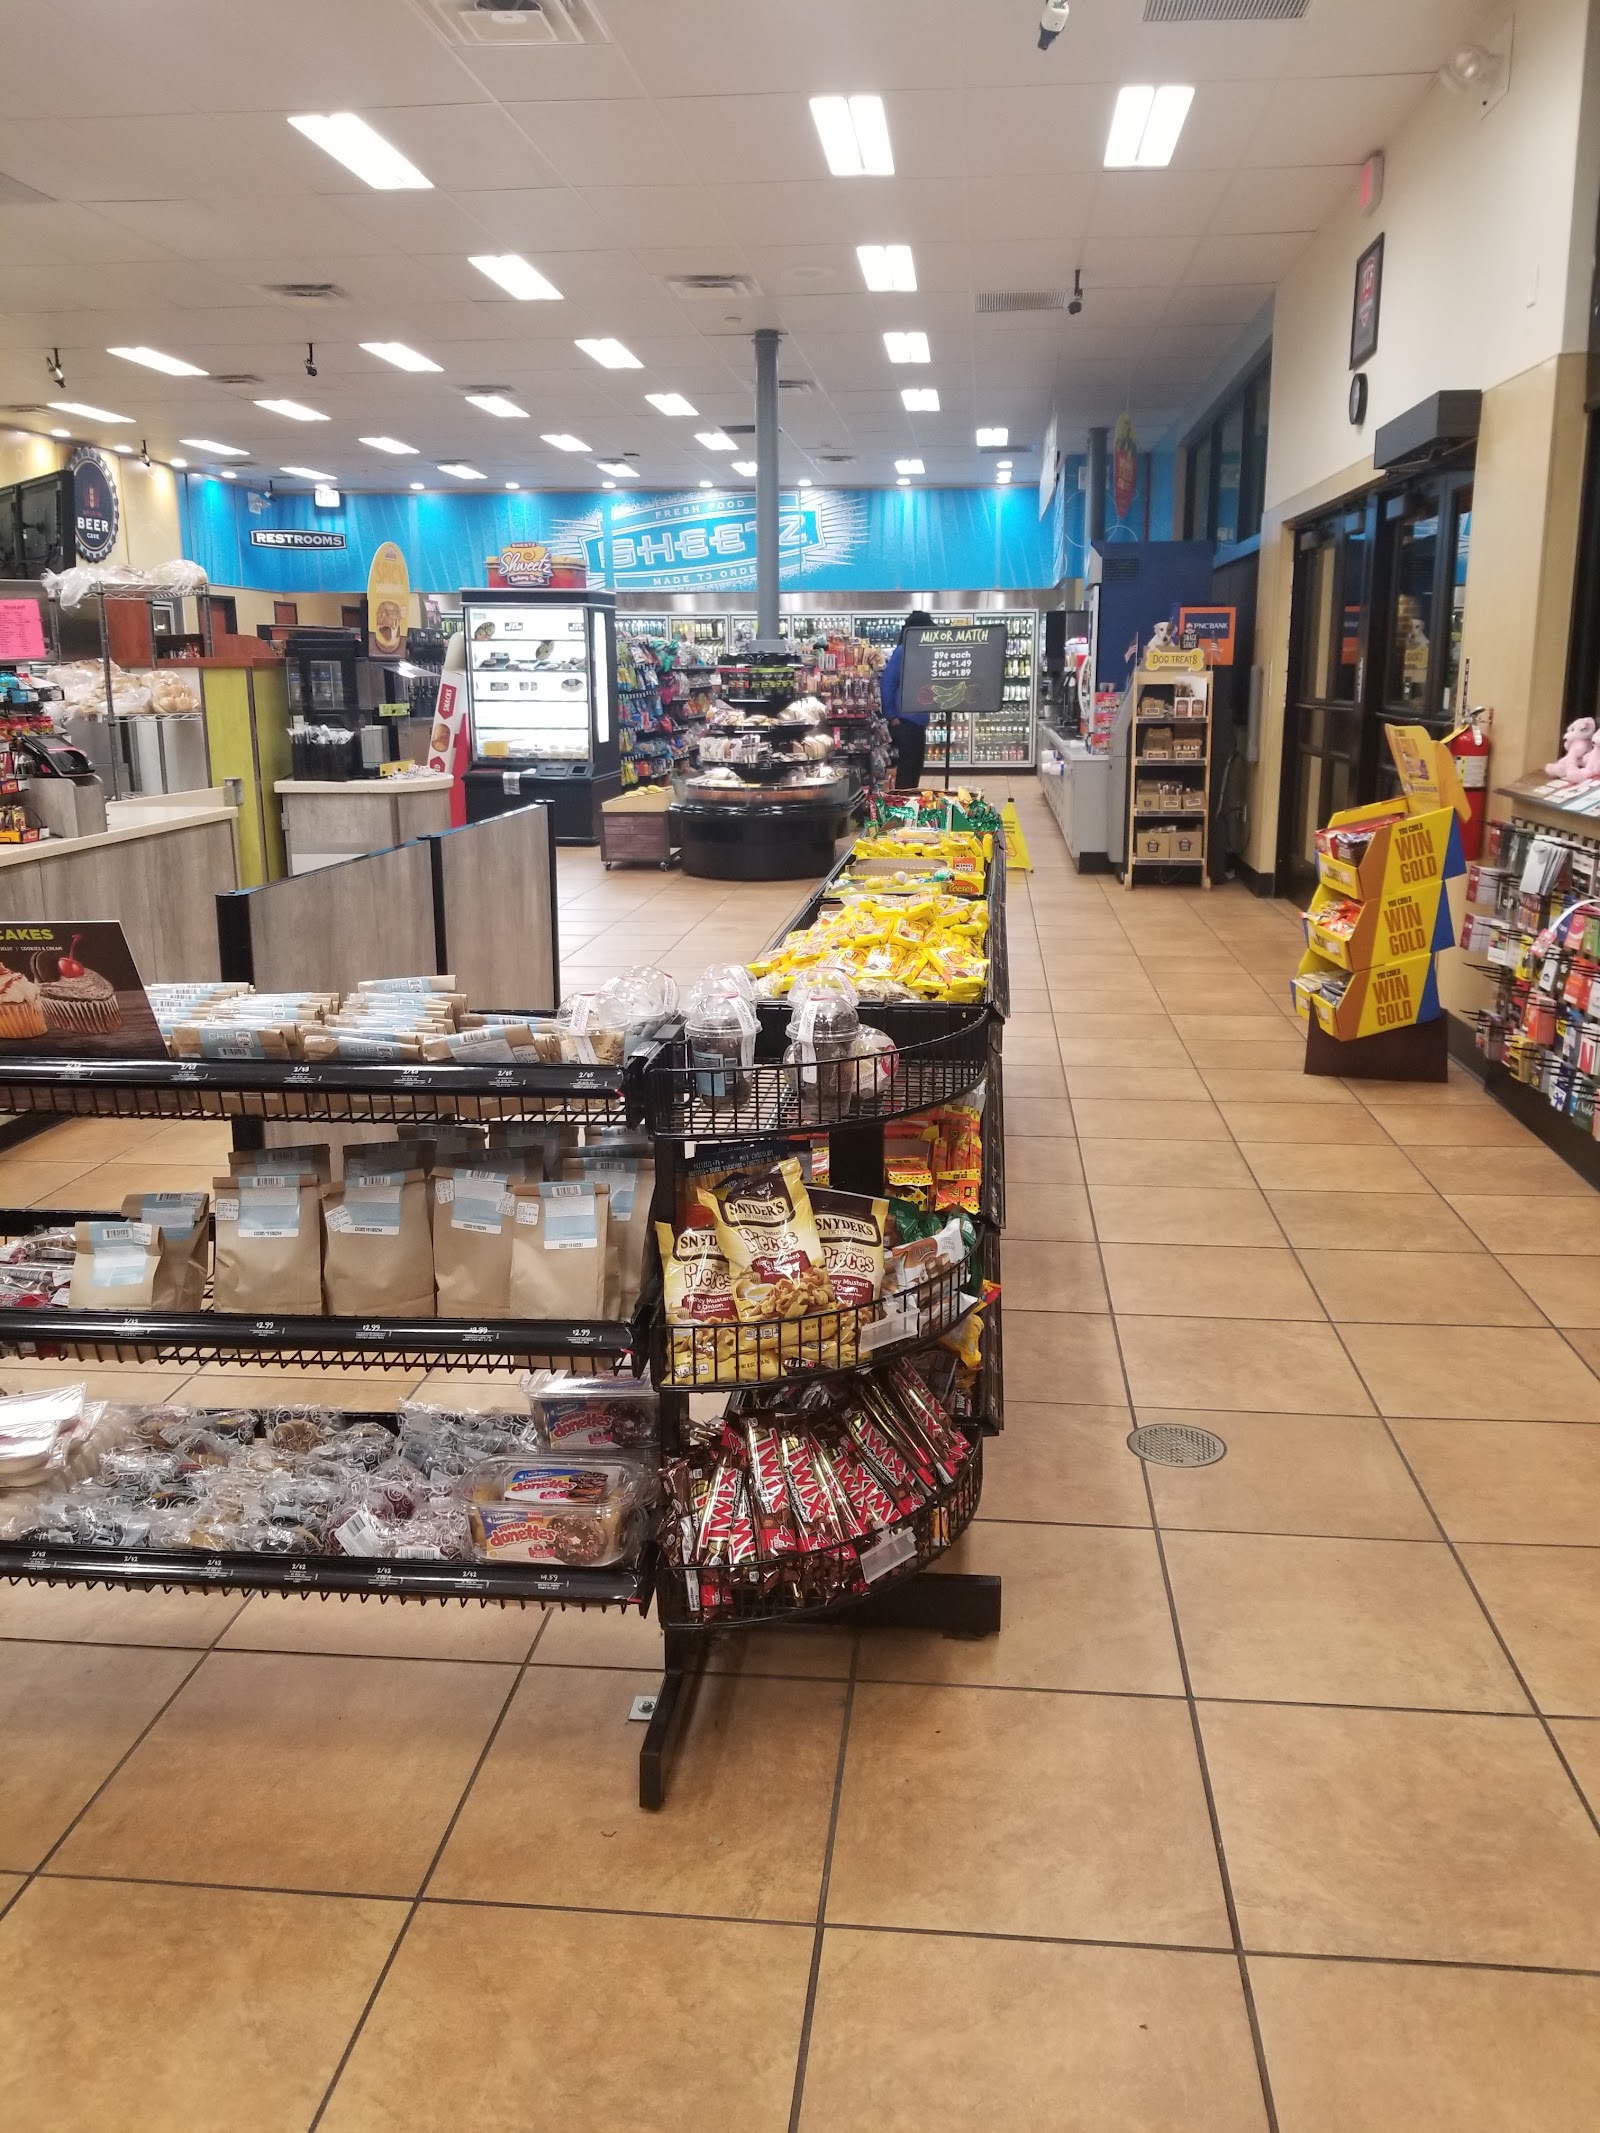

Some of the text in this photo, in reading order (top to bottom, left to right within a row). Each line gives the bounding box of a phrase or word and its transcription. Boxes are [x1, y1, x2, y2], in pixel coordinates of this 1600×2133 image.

[655, 499, 745, 519] FRESH FOOD
[77, 517, 109, 533] BEER
[86, 532, 100, 540] CAVE
[256, 533, 342, 546] RESTROOMS
[499, 552, 552, 575] Shweetz
[652, 565, 757, 585] MADE TO ORDE
[920, 628, 989, 643] MIX OR MATCH
[931, 659, 972, 668] 2 for $1.49
[934, 651, 971, 660] 89¢ each
[1153, 655, 1198, 664] DOG TREATS
[931, 668, 972, 677] 3 for $1.89
[443, 688, 453, 712] SNACKS
[1395, 829, 1434, 862] WIN
[1400, 855, 1437, 884] GOLD
[1384, 902, 1423, 934] WIN
[1389, 928, 1426, 956] GOLD
[384, 982, 406, 991] CHIP
[1373, 975, 1410, 1005] WIN
[1376, 1000, 1413, 1027] GOLD
[208, 1032, 234, 1041] CHIP
[349, 1046, 375, 1054] CHIP
[729, 1201, 785, 1216] SNYDER'S
[815, 1218, 873, 1236] SNYDER'S
[680, 1235, 718, 1250] SNYD
[738, 1228, 799, 1253] Pieces
[846, 1246, 865, 1254] Pretzel
[821, 1246, 875, 1272] Pieces
[843, 1279, 869, 1288] Mustard
[706, 1296, 733, 1304] Mustard
[256, 1321, 273, 1329] $2.99
[362, 1324, 381, 1332] $2.99
[572, 1329, 591, 1337] $2.99
[553, 1412, 613, 1438] donettes
[858, 1410, 904, 1483] TWIX
[755, 1426, 791, 1514] TWIX
[511, 1479, 577, 1492] donettes
[787, 1435, 828, 1523] TWIX
[832, 1446, 874, 1525] TWIX
[856, 1464, 903, 1525] TWIX
[700, 1467, 738, 1548] TWIX
[490, 1524, 556, 1547] donettes
[497, 1522, 527, 1534] JUMBO
